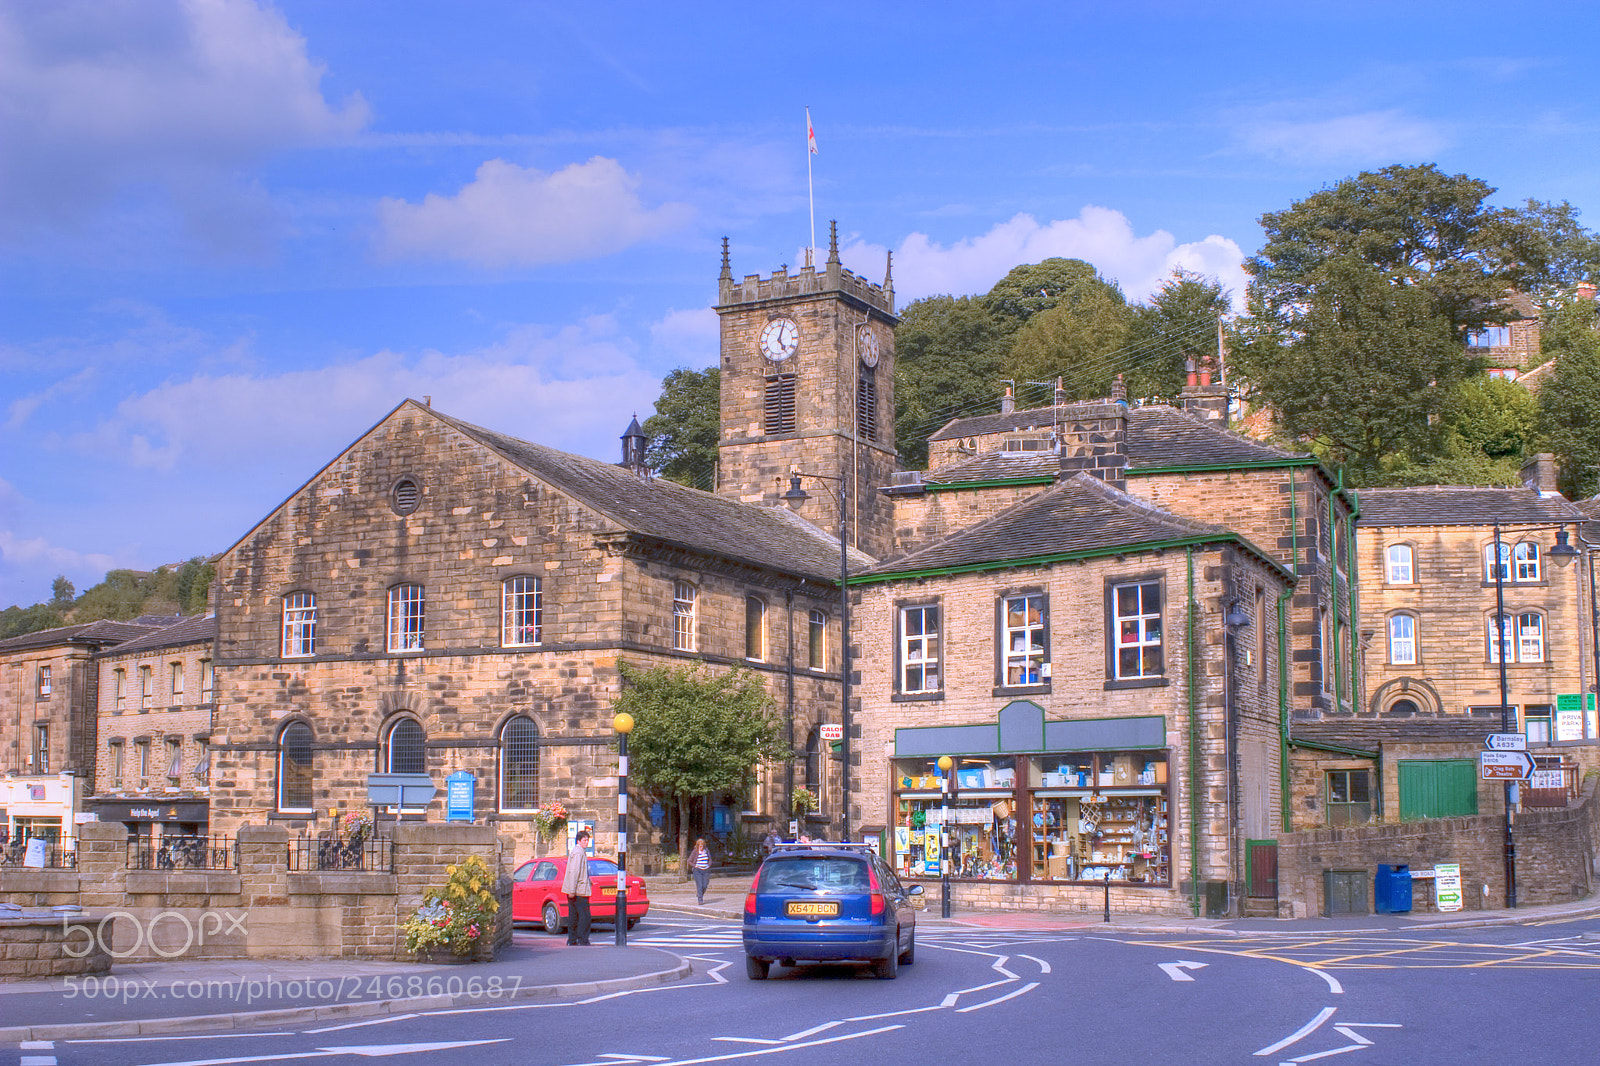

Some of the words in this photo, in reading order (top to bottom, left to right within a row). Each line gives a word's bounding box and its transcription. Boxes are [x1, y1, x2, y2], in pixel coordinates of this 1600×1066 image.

[130, 808, 140, 818] Help
[148, 808, 159, 818] Aged
[789, 904, 814, 913] X547
